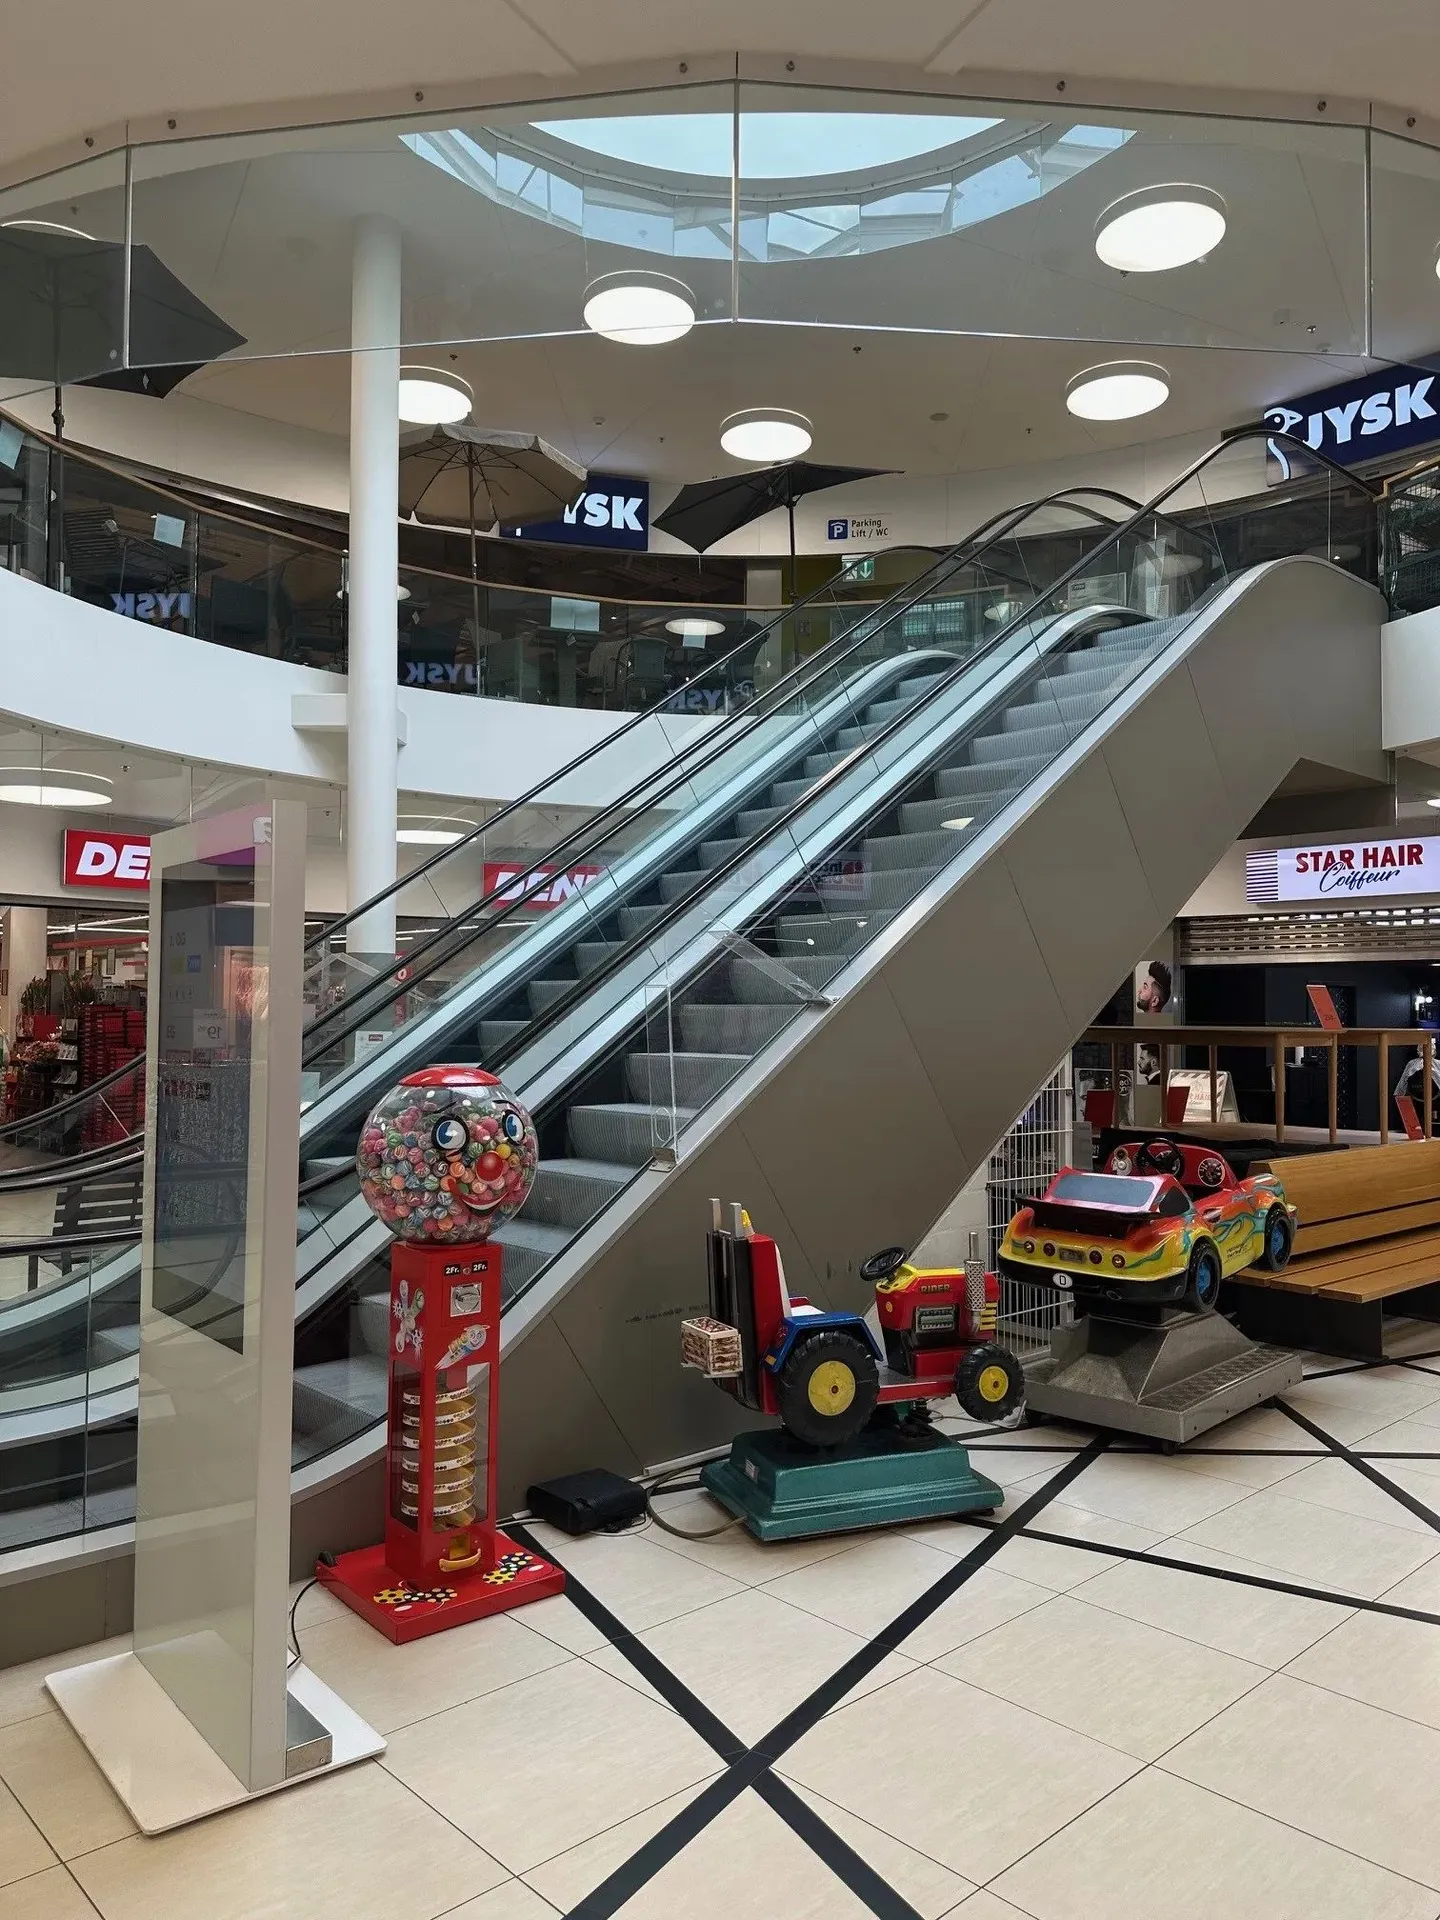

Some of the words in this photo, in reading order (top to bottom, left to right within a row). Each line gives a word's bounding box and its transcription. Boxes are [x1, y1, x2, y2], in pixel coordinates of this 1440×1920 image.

[1303, 376, 1437, 450] JYSK
[563, 492, 644, 531] YSK
[851, 519, 882, 528] Parking
[851, 530, 866, 538] Lift
[876, 528, 889, 537] WC
[76, 841, 150, 880] DE
[1296, 849, 1355, 873] STAR
[1362, 843, 1424, 869] HAIR
[1319, 862, 1400, 892] Coiffeur
[445, 1266, 460, 1275] 2Fr.
[473, 1263, 487, 1271] 2Fr.
[1060, 1275, 1067, 1286] D
[920, 1283, 951, 1294] RIDER
